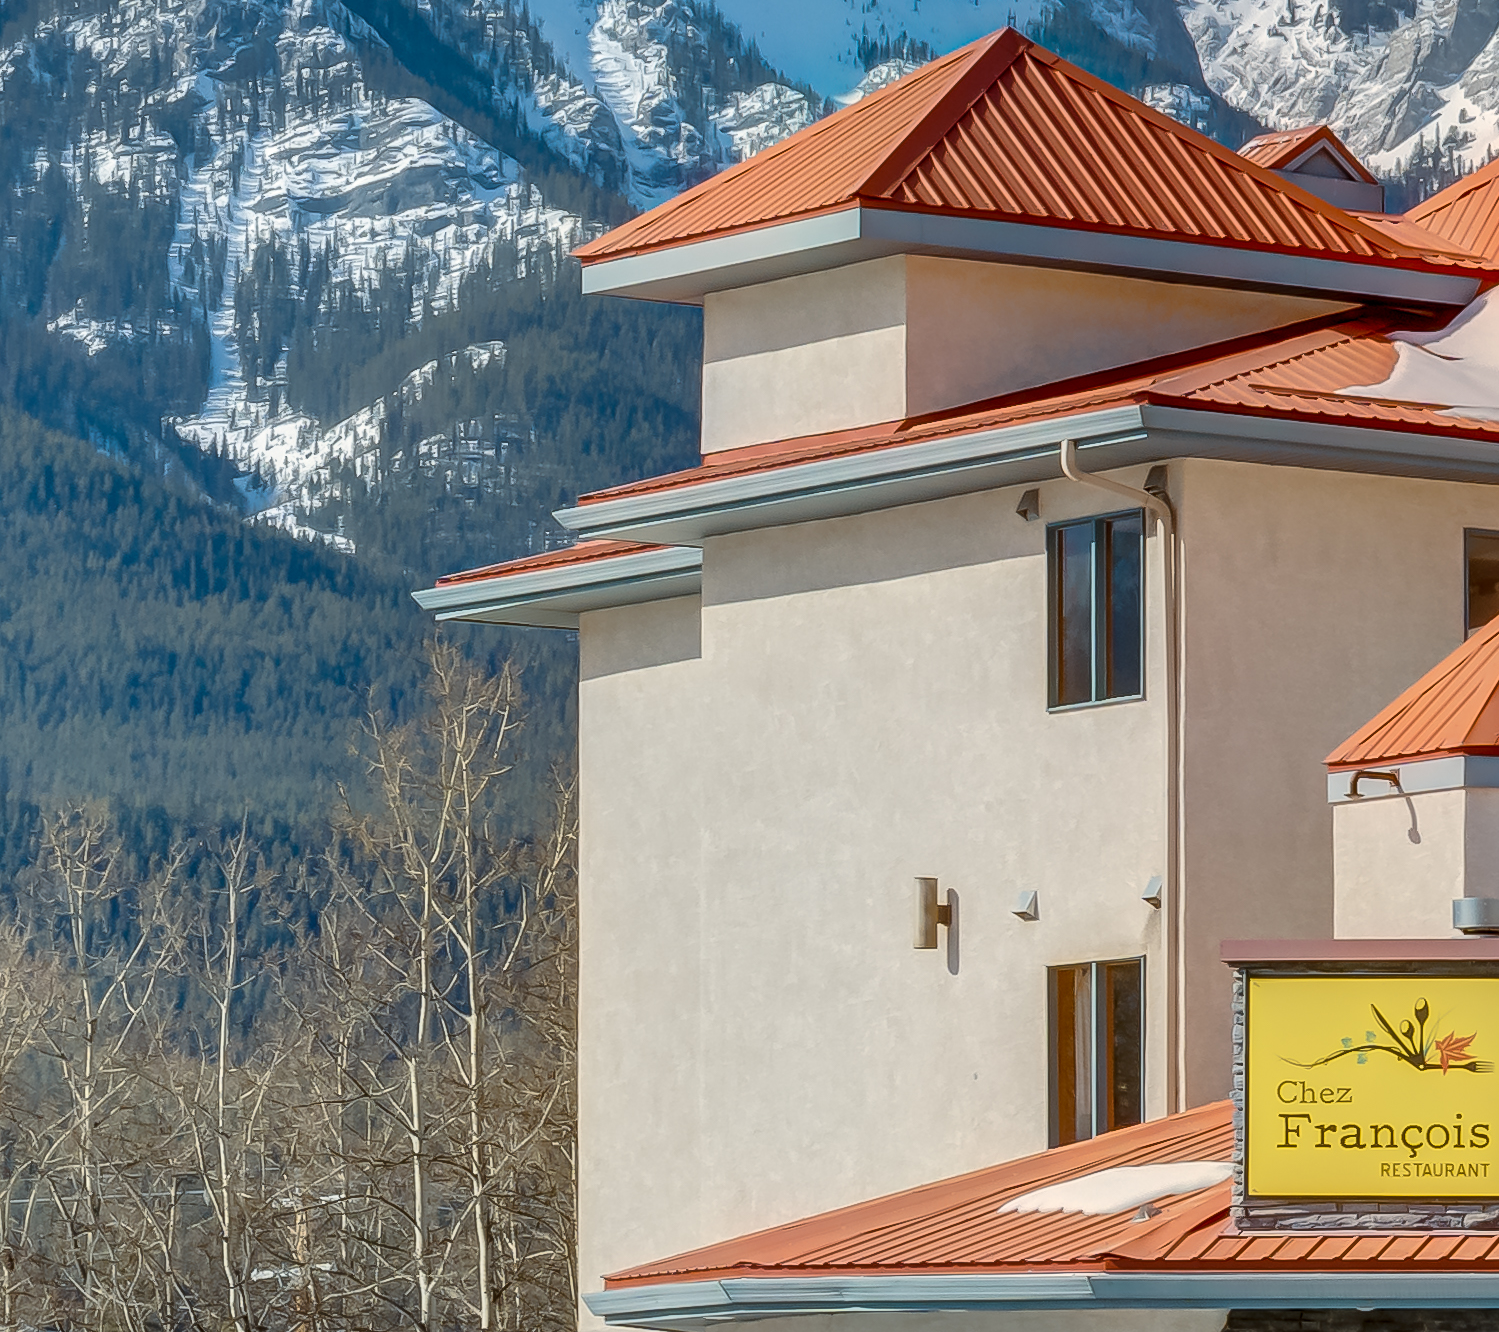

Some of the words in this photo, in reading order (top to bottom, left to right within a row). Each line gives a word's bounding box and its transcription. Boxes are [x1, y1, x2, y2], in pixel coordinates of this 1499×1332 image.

[1276, 1080, 1353, 1104] Chez
[1276, 1113, 1491, 1158] François
[1380, 1162, 1491, 1177] RESTAURANT
